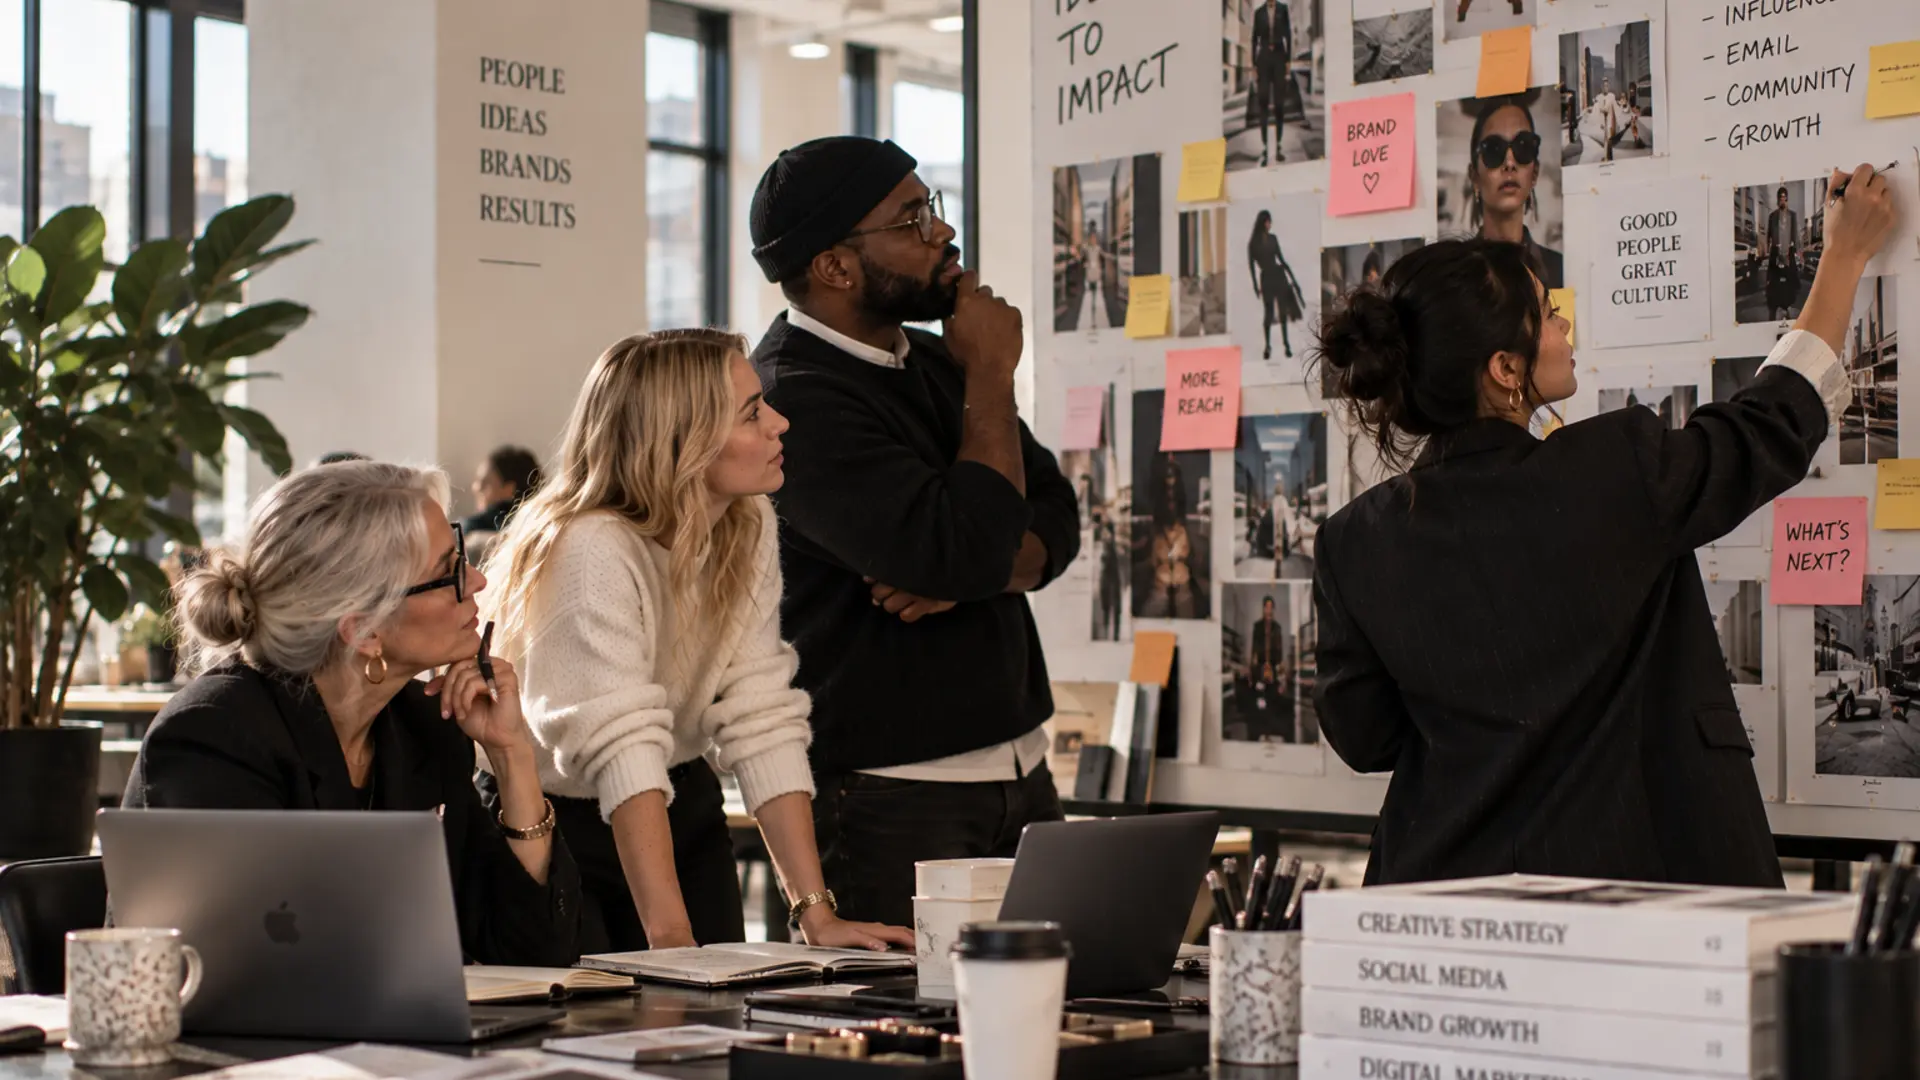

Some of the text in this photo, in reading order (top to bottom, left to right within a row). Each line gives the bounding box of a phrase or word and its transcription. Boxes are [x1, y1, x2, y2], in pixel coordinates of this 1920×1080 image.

[1057, 21, 1103, 65] TO
[1726, 34, 1799, 65] EMAIL
[480, 56, 565, 94] PEOPLE
[1058, 43, 1179, 125] IMPACT
[1726, 63, 1855, 106] COMMUNITY
[480, 102, 547, 136] IDEAS
[1347, 118, 1396, 142] BRAND
[1728, 113, 1821, 150] GROWTH
[480, 148, 572, 184] BRANDS
[1352, 144, 1389, 167] LOVE
[480, 194, 576, 229] RESULTS
[1617, 235, 1681, 257] PEOPLE
[1621, 260, 1676, 280] GREAT
[1611, 284, 1689, 305] CULTURE
[1180, 370, 1220, 389] MORE
[1178, 396, 1223, 416] REACH
[1786, 519, 1850, 542] WHAT'S
[1786, 548, 1850, 572] NEXT?
[1358, 911, 1569, 945] CREATIVE STRATEGY
[1358, 958, 1508, 990] SOCIAL MEDIA
[1359, 1006, 1539, 1044] BRAND GROWTH
